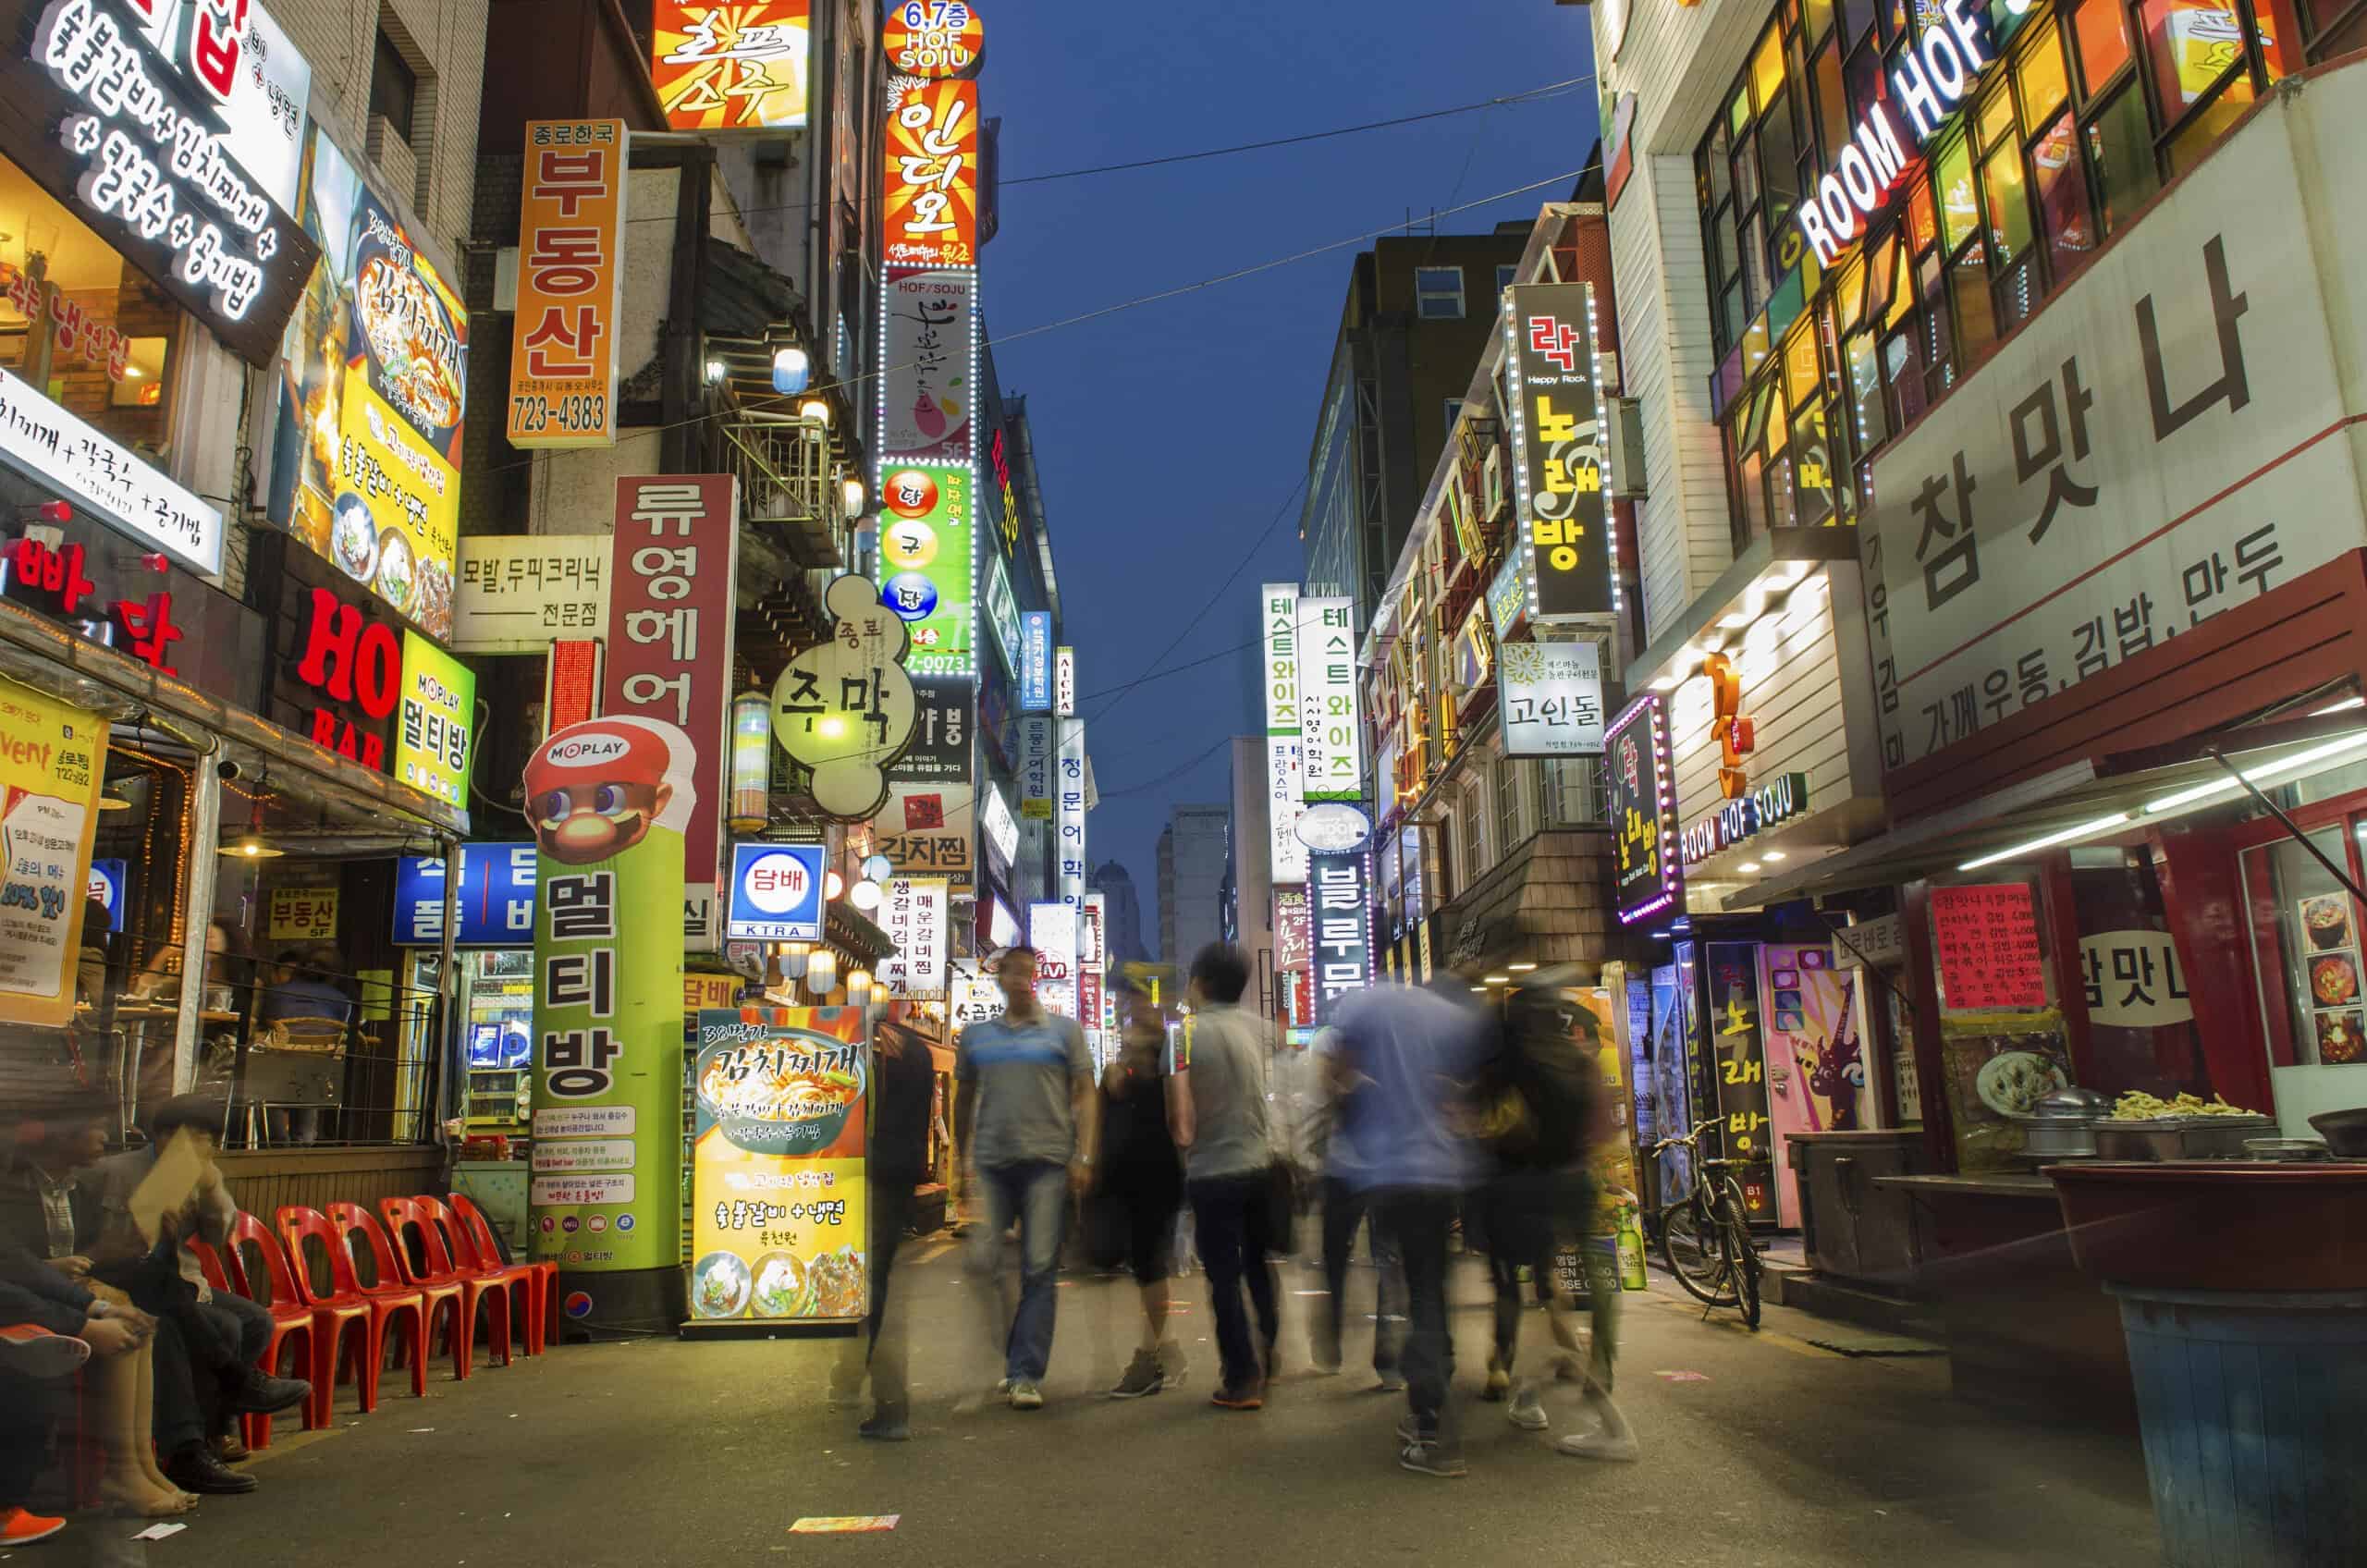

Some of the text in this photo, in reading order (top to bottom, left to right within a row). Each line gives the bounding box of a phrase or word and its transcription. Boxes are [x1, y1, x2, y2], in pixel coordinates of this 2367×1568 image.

[661, 8, 791, 65] 호프
[898, 48, 969, 68] SOJU
[905, 31, 963, 50] HOF
[664, 58, 790, 125] 소주
[533, 124, 614, 147] 종로한국
[1798, 0, 1985, 270] ROOM HOF
[187, 232, 259, 312] 공기밥
[522, 148, 608, 380] 부동산
[1528, 315, 1580, 372] 락
[1527, 374, 1587, 386] Happy Rock
[513, 395, 605, 432] 723-4383
[1910, 232, 2251, 613] 참맛나
[1533, 395, 1600, 571] 노래방
[154, 497, 202, 547] 공기밥
[542, 601, 598, 629] 전문점
[621, 483, 706, 727] 류영헤어
[297, 588, 402, 720] HO
[837, 619, 883, 649] 종로
[1270, 598, 1297, 724] 테스트와이즈
[416, 673, 461, 712] MOPLAY
[781, 667, 891, 745] 주막
[1322, 606, 1355, 777] 테스트와이즈
[1507, 694, 1601, 728] 고인돌
[402, 697, 469, 773] 멀티방
[550, 741, 625, 759] MOPLAY
[1274, 745, 1289, 802] 프랑스어
[1619, 805, 1658, 877] 노래방
[1680, 771, 1794, 866] ROOM HOF SOJU
[878, 835, 966, 866] 김치찜
[754, 869, 803, 892] 담배
[273, 901, 334, 929] 부동산
[745, 925, 801, 937] KTRA
[914, 894, 934, 975] 매운갈비찜
[1293, 915, 1306, 925] 2F
[542, 870, 623, 1100] 멀티방
[684, 979, 730, 1007] 담배
[716, 1044, 859, 1082] 김치찌개
[1720, 998, 1770, 1151] 노래방
[806, 1198, 846, 1227] 냉면
[1747, 1185, 1761, 1196] B1
